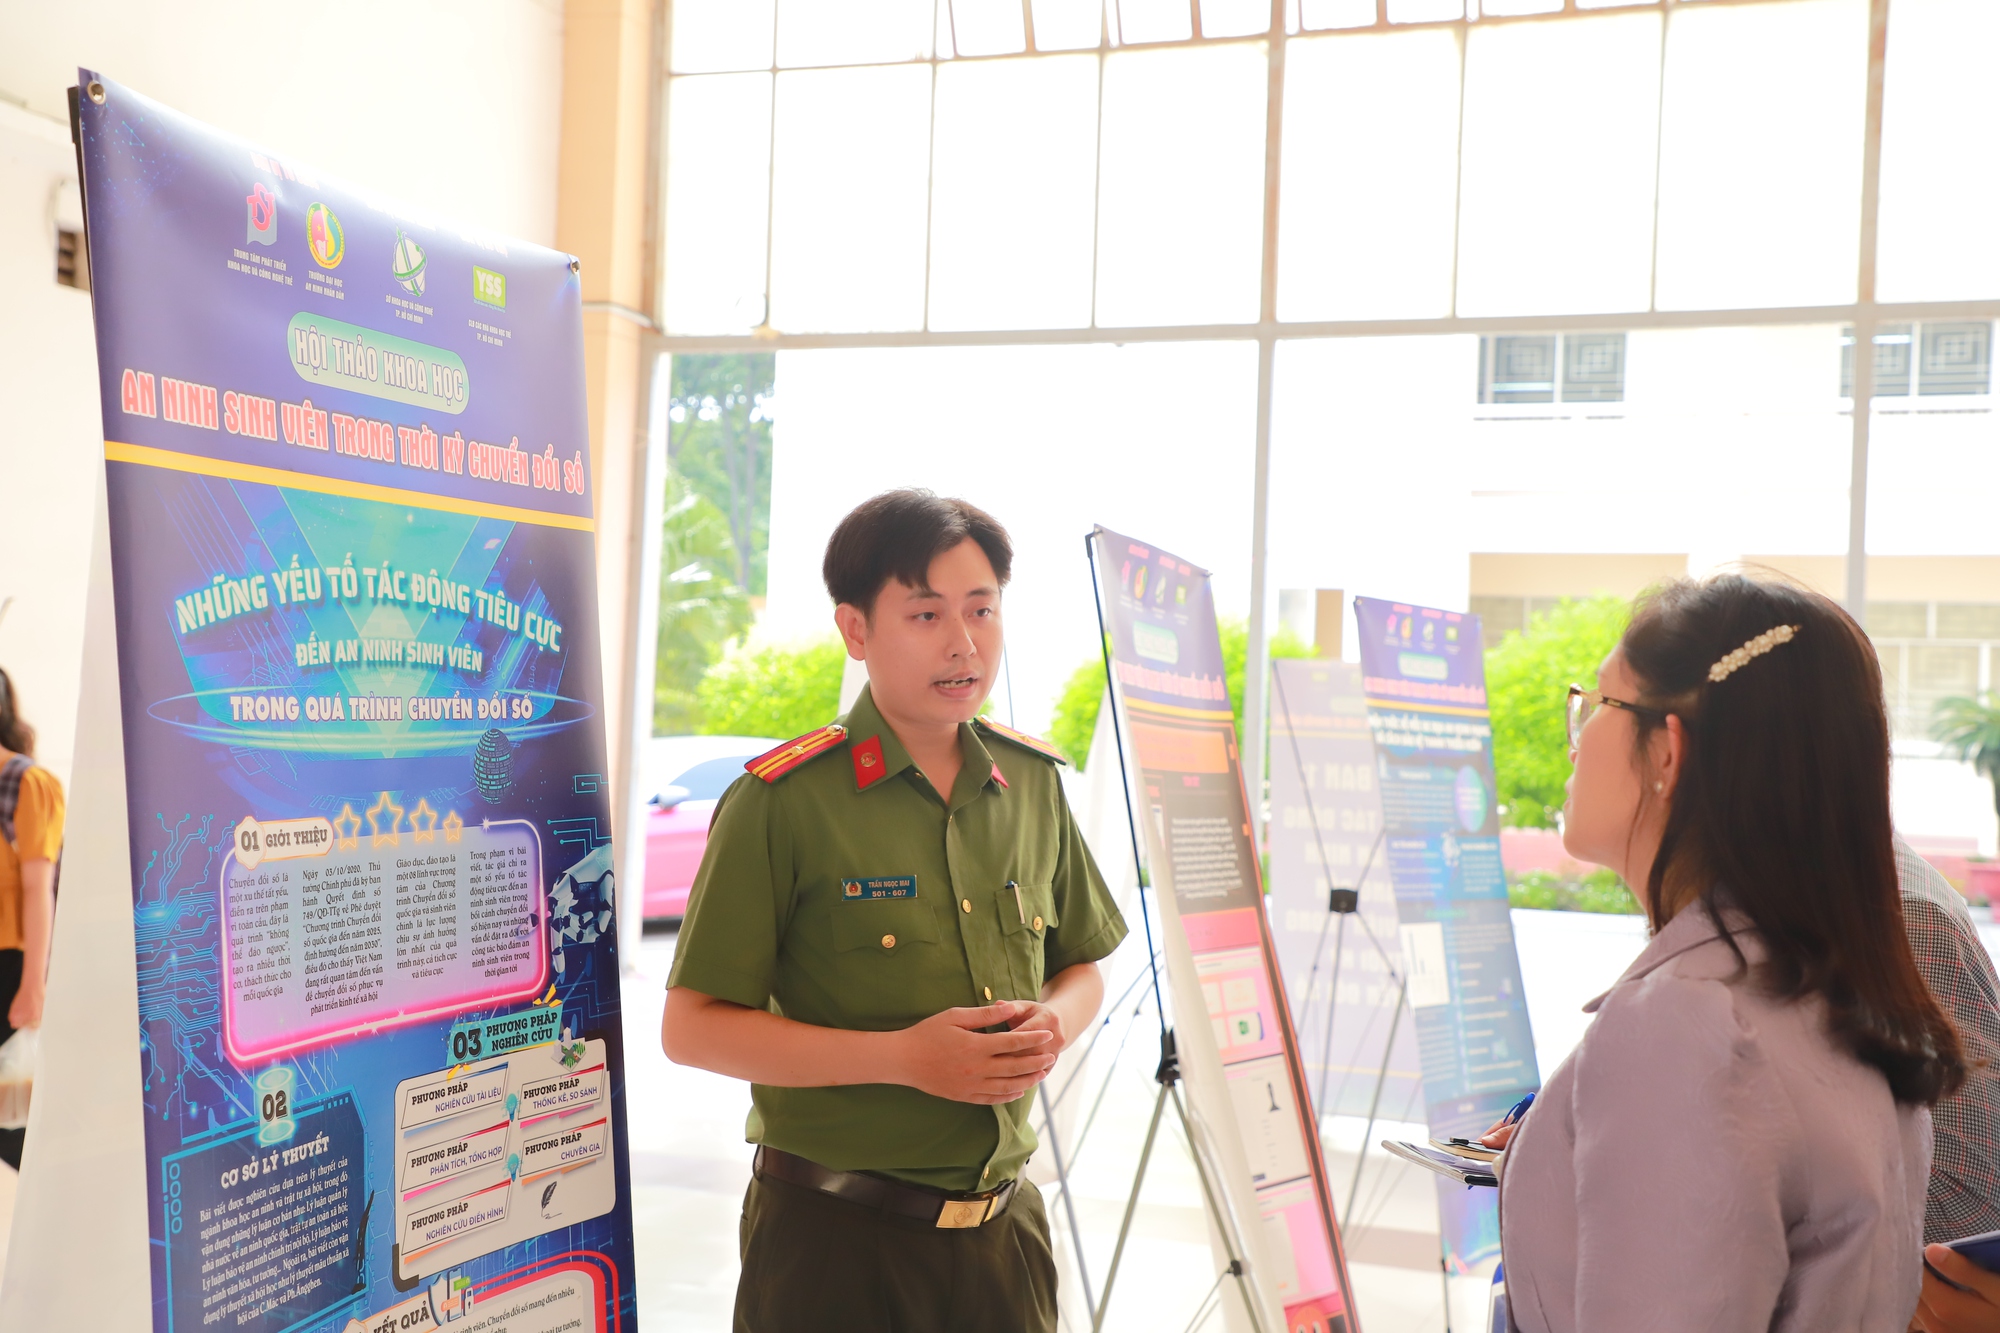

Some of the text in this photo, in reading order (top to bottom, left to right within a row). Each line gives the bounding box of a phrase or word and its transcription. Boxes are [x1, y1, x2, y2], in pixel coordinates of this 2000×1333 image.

[476, 270, 502, 298] YSS
[295, 325, 464, 406] HỘI THẢO KHOA HỌC
[122, 368, 584, 495] AN NINH SINH VIÊN TRONG THỜI KỲ CHUYỂN ĐỔI SỐ
[176, 552, 562, 652] NHỮNG YẾU TỐ TÁC ĐỘNG TIÊU CỰC
[296, 631, 482, 672] ĐẾN AN NINH SINH VIÊN
[230, 690, 533, 723] TRONG QUÁ TRÌNH CHUYỂN ĐỔI SỐ
[241, 831, 260, 851] 01
[266, 826, 327, 848] GIỚI THIỆU
[487, 1011, 557, 1037] PHƯƠNG PHÁP
[454, 1028, 481, 1060] 03
[492, 1027, 552, 1051] NGHIÊN CỨU
[412, 1082, 468, 1105] PHƯƠNG PHÁP
[435, 1087, 501, 1112] NGHIÊN CỨU TÀI LIỆU
[524, 1078, 579, 1099] PHƯƠNG PHÁP
[533, 1097, 556, 1109] THỐNG
[570, 1091, 578, 1100] SO
[580, 1087, 597, 1097] SÁNH
[262, 1090, 287, 1121] 02
[411, 1142, 468, 1167] PHƯƠNG PHÁP
[525, 1132, 581, 1155] PHƯƠNG PHÁP
[561, 1143, 600, 1160] CHUYÊN GIA
[221, 1131, 329, 1189] CƠ SỞ LÝ THUYẾT
[430, 1163, 449, 1175] PHÂN
[469, 1151, 486, 1163] TỔNG
[488, 1146, 502, 1156] HỢP
[412, 1202, 468, 1230] PHƯƠNG PHÁP
[426, 1224, 451, 1240] NGHIÊN
[453, 1219, 467, 1231] CỨU
[487, 1207, 503, 1219] HÌNH
[401, 1301, 429, 1329] QUẢ
